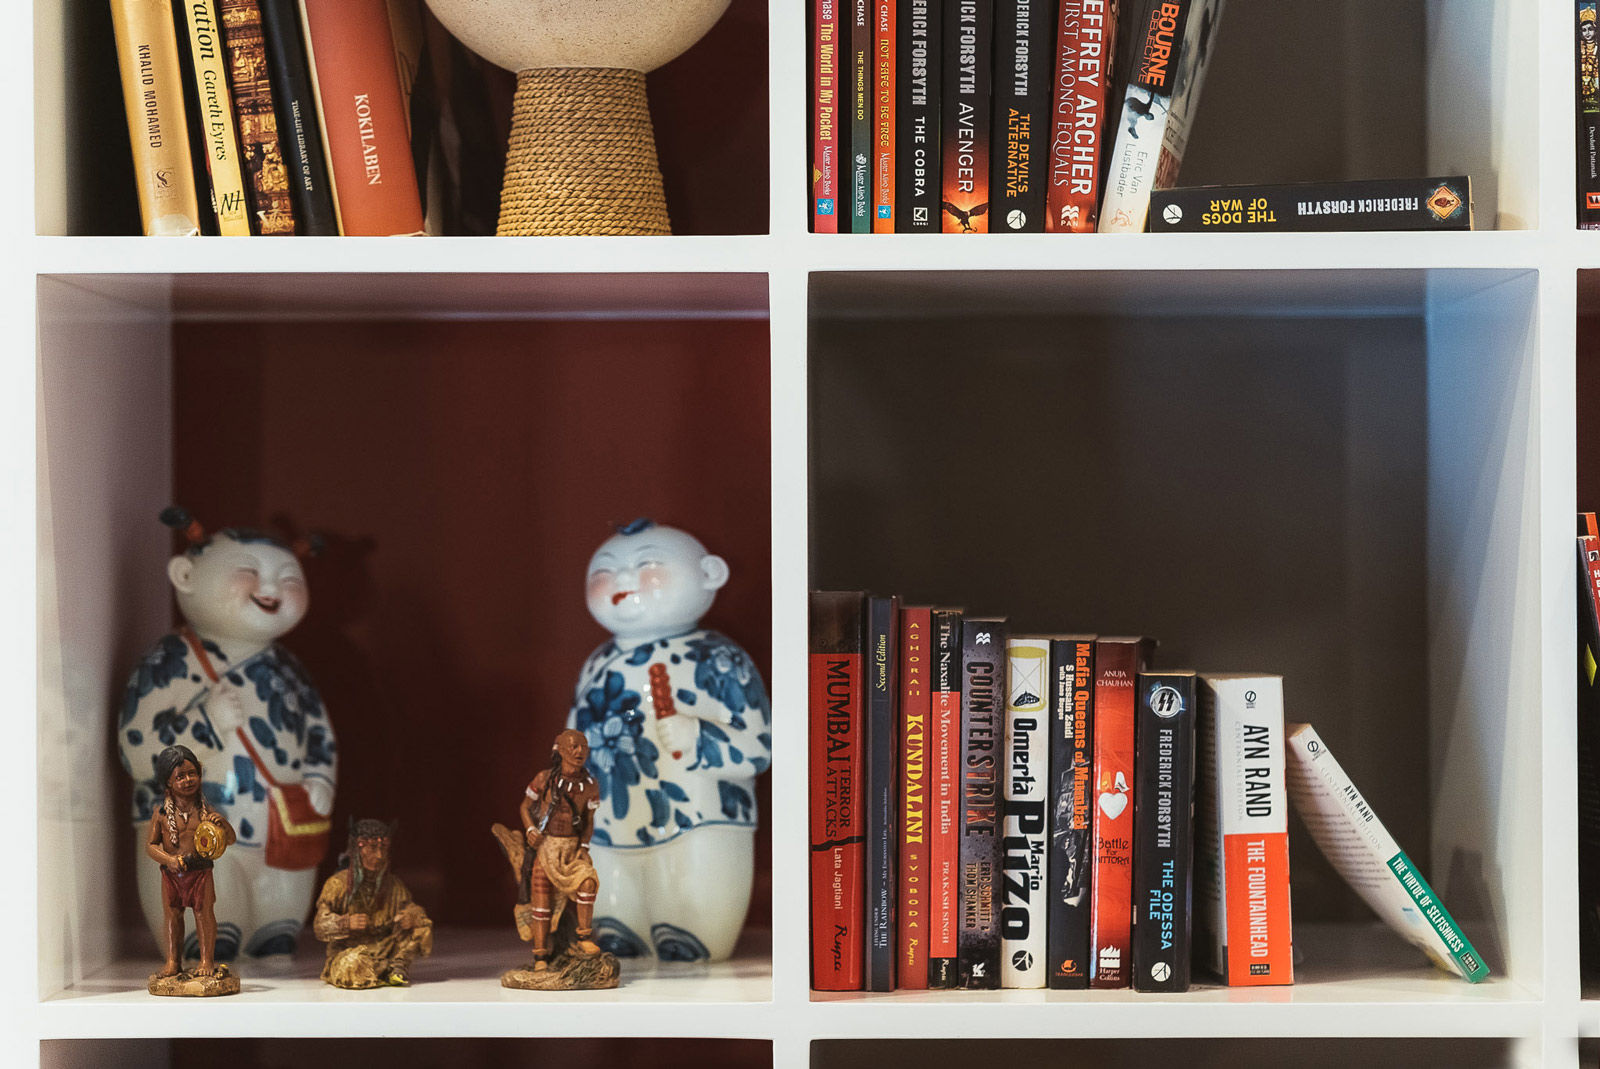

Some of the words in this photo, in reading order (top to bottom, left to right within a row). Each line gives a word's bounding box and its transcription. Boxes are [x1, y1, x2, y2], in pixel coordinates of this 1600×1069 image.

[193, 0, 214, 60] ation
[857, 0, 865, 26] CHASE
[820, 23, 833, 42] The
[1138, 9, 1160, 84] OBJECTIVE
[1146, 2, 1180, 86] BOURNE
[137, 44, 154, 86] KHALID
[820, 44, 833, 74] World
[880, 61, 889, 88] SAFE
[912, 40, 927, 105] FORSYTH
[959, 26, 976, 94] FORSYTH
[1014, 40, 1029, 96] FORSYTH
[203, 69, 222, 120] Gareth
[819, 89, 833, 104] My
[880, 90, 889, 103] TO
[1058, 45, 1077, 115] AMONG
[144, 90, 161, 148] MOHAMED
[291, 100, 303, 134] TIME-LIFE
[820, 106, 833, 141] Pocket
[857, 110, 864, 120] DO
[880, 106, 889, 120] BE
[915, 116, 925, 143] THE
[1019, 113, 1030, 139] THE
[211, 121, 226, 161] Eyres
[297, 134, 309, 164] LIBRARY
[354, 94, 382, 186] KOKILABEN
[880, 122, 889, 147] FREE
[958, 102, 974, 192] AVENGER
[1006, 108, 1020, 198] ALTERNATIVE
[1070, 94, 1098, 195] ARCHER
[302, 165, 310, 175] OF
[914, 149, 925, 197] COBRA
[1017, 144, 1030, 193] DEVIL'S
[1053, 122, 1073, 186] EQUALS
[1117, 144, 1136, 197] Lustbader
[1136, 151, 1148, 170] Eric
[304, 176, 313, 191] ART
[1130, 172, 1143, 194] Van
[1202, 211, 1243, 225] DOGS
[1210, 199, 1243, 212] WAR
[1249, 197, 1268, 211] OF
[1249, 210, 1277, 224] THE
[1297, 200, 1355, 216] FORSYTH
[1358, 197, 1418, 213] FREDERICK
[876, 634, 886, 661] Edition
[910, 623, 920, 685] AGHORA
[940, 624, 950, 649] The
[875, 661, 886, 692] Second
[940, 652, 951, 706] Naxalite
[1066, 664, 1074, 672] S
[1075, 643, 1090, 688] Mafia
[826, 660, 850, 763] MUMBAI
[1065, 674, 1074, 712] Hussain
[1064, 714, 1073, 739] Zaidi
[1075, 690, 1090, 749] Queens
[940, 709, 951, 779] Movement
[1075, 752, 1087, 763] of
[1159, 729, 1173, 788] FREDERICK
[1243, 725, 1270, 759] AYN
[839, 766, 851, 828] TERROR
[906, 714, 924, 844] KUNDALINI
[940, 783, 951, 796] in
[1074, 766, 1089, 830] Mumbai
[1245, 768, 1272, 817] RAND
[825, 768, 838, 838] ATTACKS
[940, 799, 951, 834] India
[1157, 792, 1172, 848] FORSYTH
[1344, 785, 1358, 801] AYN
[1355, 800, 1374, 823] RAND
[834, 848, 843, 869] Lata
[1002, 800, 1045, 940] Puzo
[1030, 840, 1045, 891] Mario
[1247, 840, 1265, 863] THE
[832, 871, 844, 910] Jagtiani
[908, 854, 919, 928] SVOBODA
[942, 862, 950, 909] PRAKASH
[966, 863, 978, 887] THOM
[980, 862, 992, 882] ERIC
[1162, 860, 1174, 888] THE
[879, 888, 888, 930] RAINBOW
[966, 889, 978, 929] SHANKER
[980, 884, 992, 922] SCHMITT
[1149, 889, 1161, 920] FILE
[1161, 892, 1174, 950] ODESSA
[1248, 865, 1269, 958] FOUNTAINHEAD
[1392, 857, 1408, 875] THE
[1403, 871, 1426, 900] VIRTUE
[1419, 895, 1433, 908] OF
[1426, 905, 1464, 953] SELFISHNESS
[942, 912, 950, 944] SINGH
[1099, 968, 1120, 976] Harper
